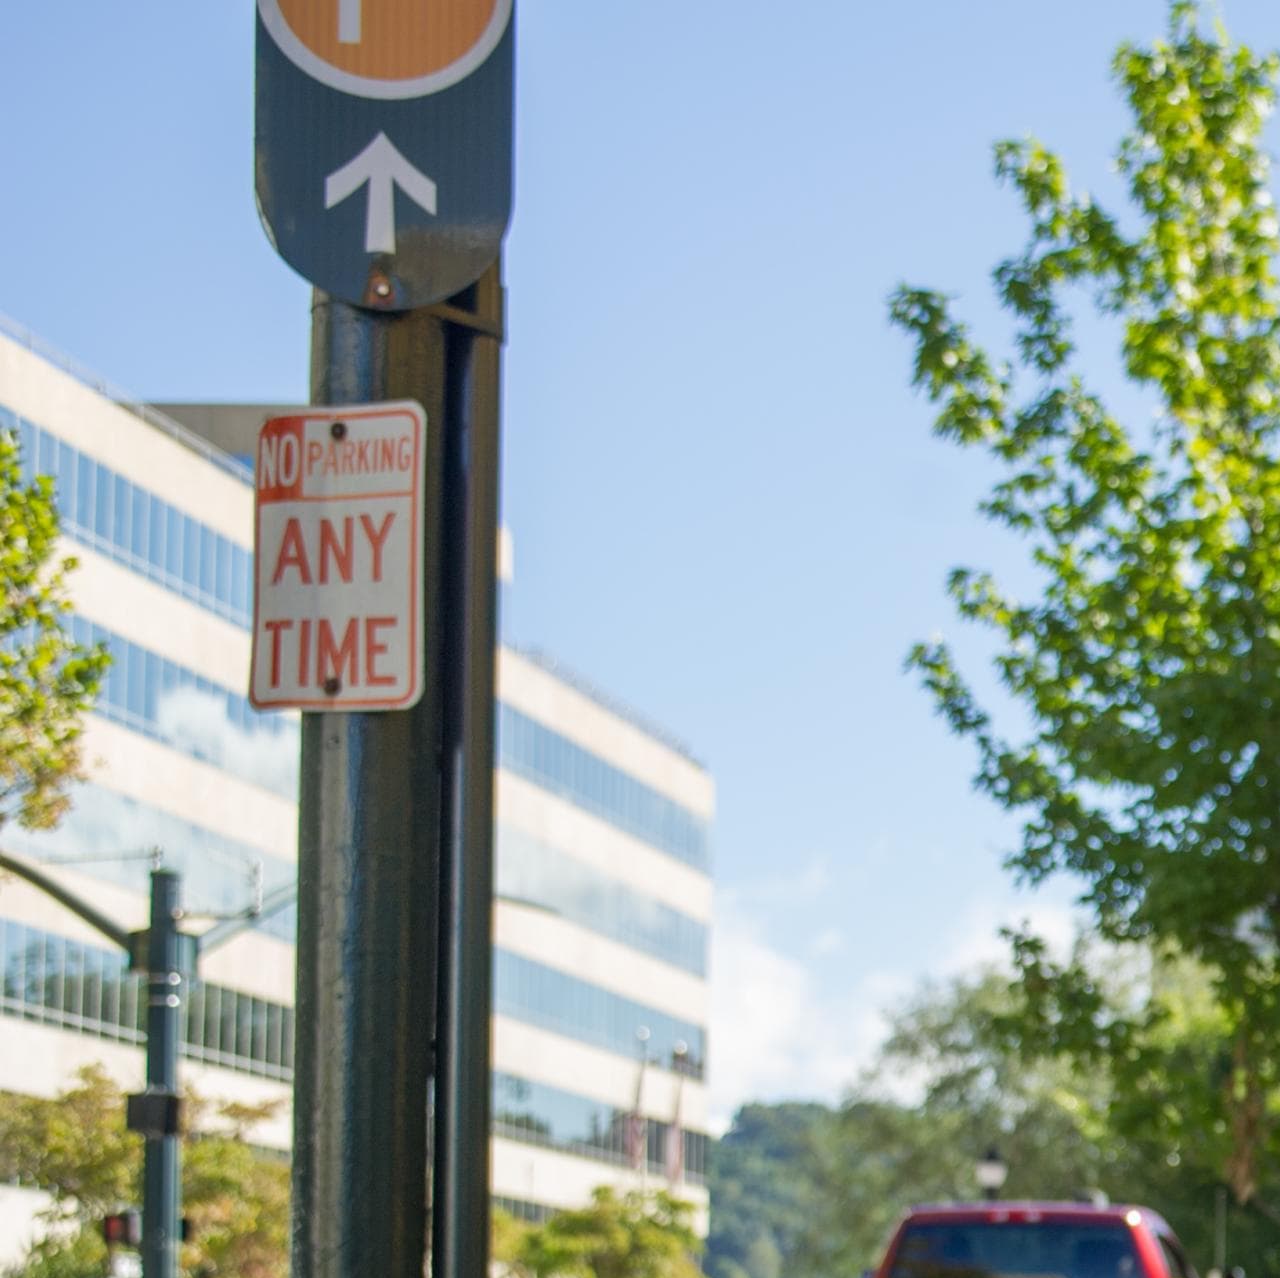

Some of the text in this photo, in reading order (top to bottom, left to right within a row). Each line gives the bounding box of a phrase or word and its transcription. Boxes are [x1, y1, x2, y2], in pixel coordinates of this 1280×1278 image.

[259, 434, 411, 490] NO PARKING
[271, 512, 396, 585] ANY
[265, 617, 397, 688] TIME
